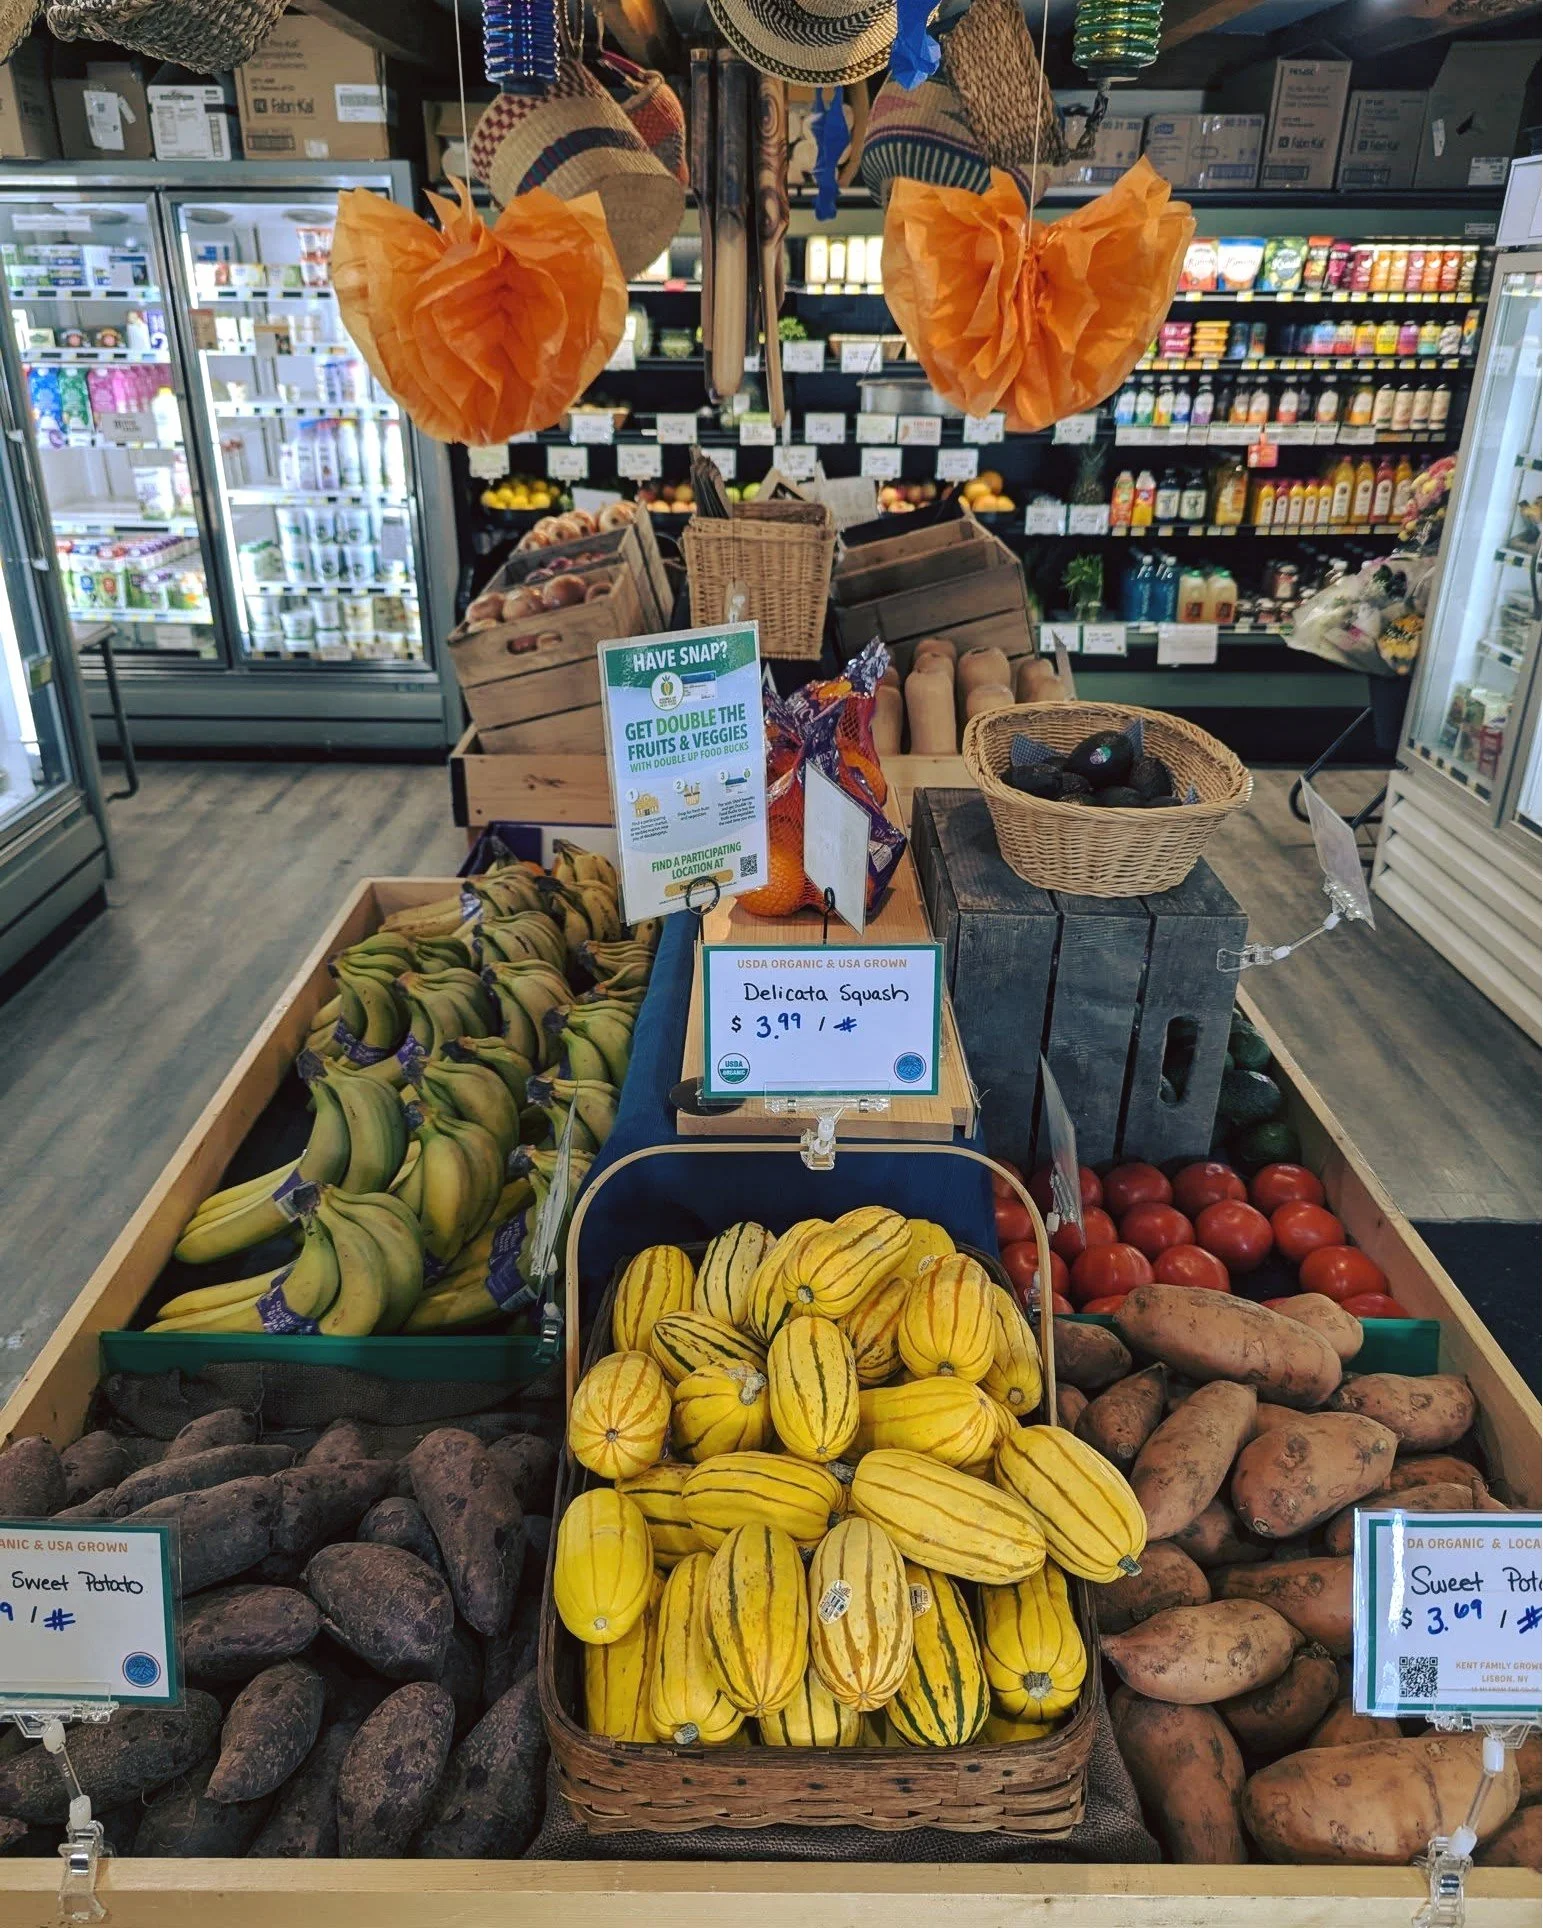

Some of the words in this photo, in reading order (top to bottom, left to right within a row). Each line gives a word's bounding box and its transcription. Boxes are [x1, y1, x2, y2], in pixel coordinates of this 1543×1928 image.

[633, 649, 677, 673] HAVE
[679, 640, 728, 666] SNAP?
[625, 720, 653, 742] GET
[655, 707, 716, 737] DOUBLE
[718, 703, 746, 723] THE
[627, 737, 676, 762] FRUITS
[679, 734, 691, 750] &
[692, 723, 748, 748] VEGGIES
[630, 758, 653, 773] WITH
[654, 754, 686, 770] DOUBLE
[687, 751, 699, 764] UP
[700, 746, 722, 762] FOOD
[723, 741, 750, 758] BUCKS
[676, 780, 682, 790] 2
[720, 771, 726, 781] 3
[651, 859, 672, 873] FIND
[673, 856, 680, 868] A
[681, 841, 741, 865] PARTICIPATING
[672, 862, 713, 880] LOCATION
[714, 857, 724, 869] AT
[737, 959, 769, 969] USDA
[771, 959, 823, 969] ORGANIC
[827, 959, 836, 969] &
[838, 959, 861, 969] USA
[864, 958, 907, 969] GROWN
[743, 982, 829, 1002] Delicata
[839, 983, 909, 1006] Squash
[731, 1015, 742, 1033] $
[756, 1012, 801, 1040] 3.99
[818, 1016, 825, 1031] /
[34, 1540, 43, 1550] &
[47, 1541, 73, 1551] USA
[77, 1541, 128, 1553] GROWN
[1407, 1538, 1424, 1549] DA
[1428, 1538, 1485, 1549] ORGANIC
[1492, 1538, 1501, 1549] &
[1508, 1538, 1542, 1549] LOCA
[12, 1570, 70, 1591] Sweet
[77, 1570, 144, 1595] Potato
[1411, 1565, 1484, 1595] Sweet
[30, 1606, 38, 1623] /
[43, 1608, 76, 1631] #
[1401, 1607, 1413, 1630] $
[1499, 1609, 1507, 1629] /
[1455, 1661, 1478, 1670] KENT
[1479, 1661, 1512, 1670] FAMILY
[1517, 1674, 1529, 1683] NY
